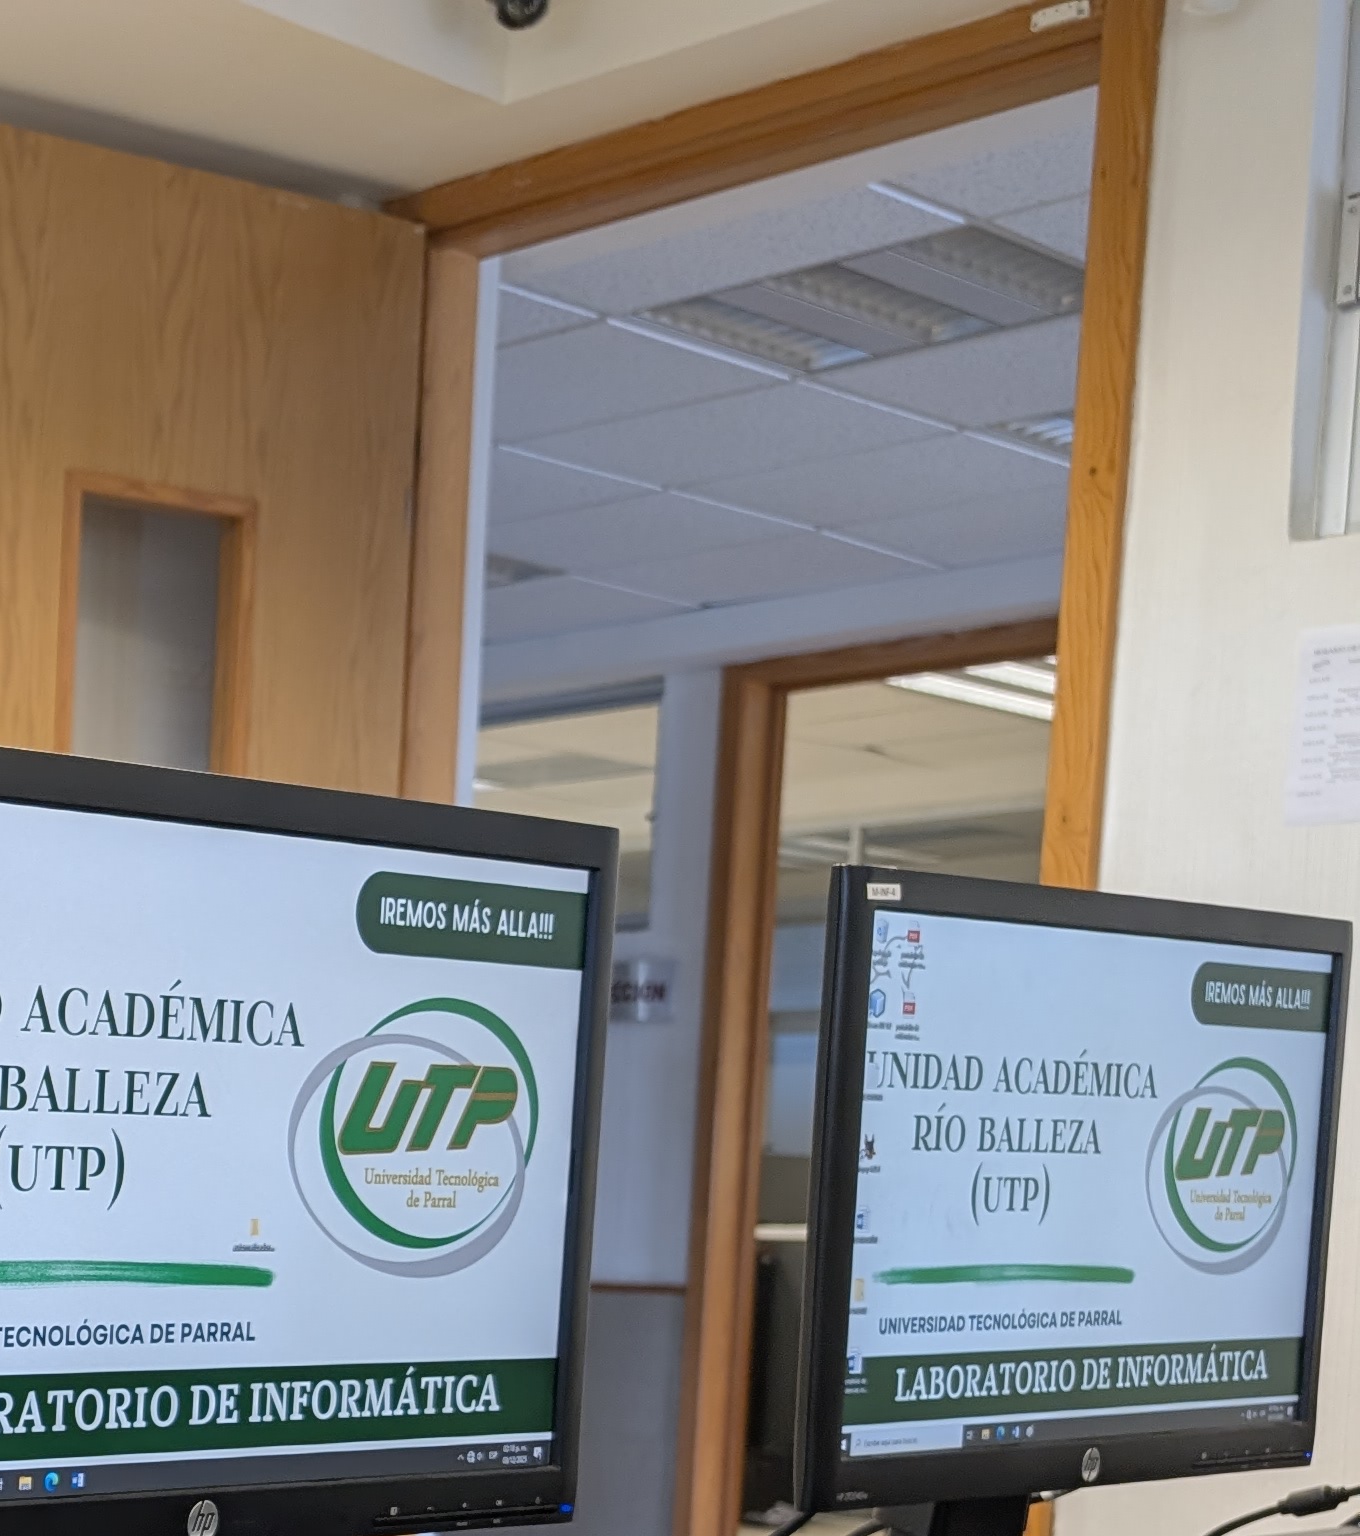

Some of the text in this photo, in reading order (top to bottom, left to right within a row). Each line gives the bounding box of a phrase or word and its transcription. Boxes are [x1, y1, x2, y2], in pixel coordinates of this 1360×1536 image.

[380, 896, 555, 940] IREMOS MÁS ALLA!!!
[20, 979, 305, 1047] ACADÉMICA
[1204, 980, 1312, 1010] IREMOS MÁS ALLA!!!
[993, 1049, 1158, 1099] ACADÉMICA
[338, 1061, 519, 1156] UTP
[912, 1103, 1101, 1154] RÍO BALLEZA
[1175, 1107, 1285, 1181] UTP
[364, 1167, 500, 1193] Universidad Tecnológica
[406, 1190, 457, 1209] de Parral
[970, 1163, 1050, 1225] (UTP)
[1190, 1188, 1272, 1208] Universidad Tecnológica
[1215, 1207, 1246, 1222] de Parral
[150, 1323, 176, 1344] DE
[180, 1321, 256, 1343] PARRAL
[879, 1308, 1122, 1335] UNIVERSIDAD TECNOLÓGICA DE PARRAL
[188, 1383, 239, 1426] DE
[249, 1366, 500, 1422] INFORMÁTICA
[895, 1343, 1269, 1402] LABORATORIO DE INFORMÁTICA
